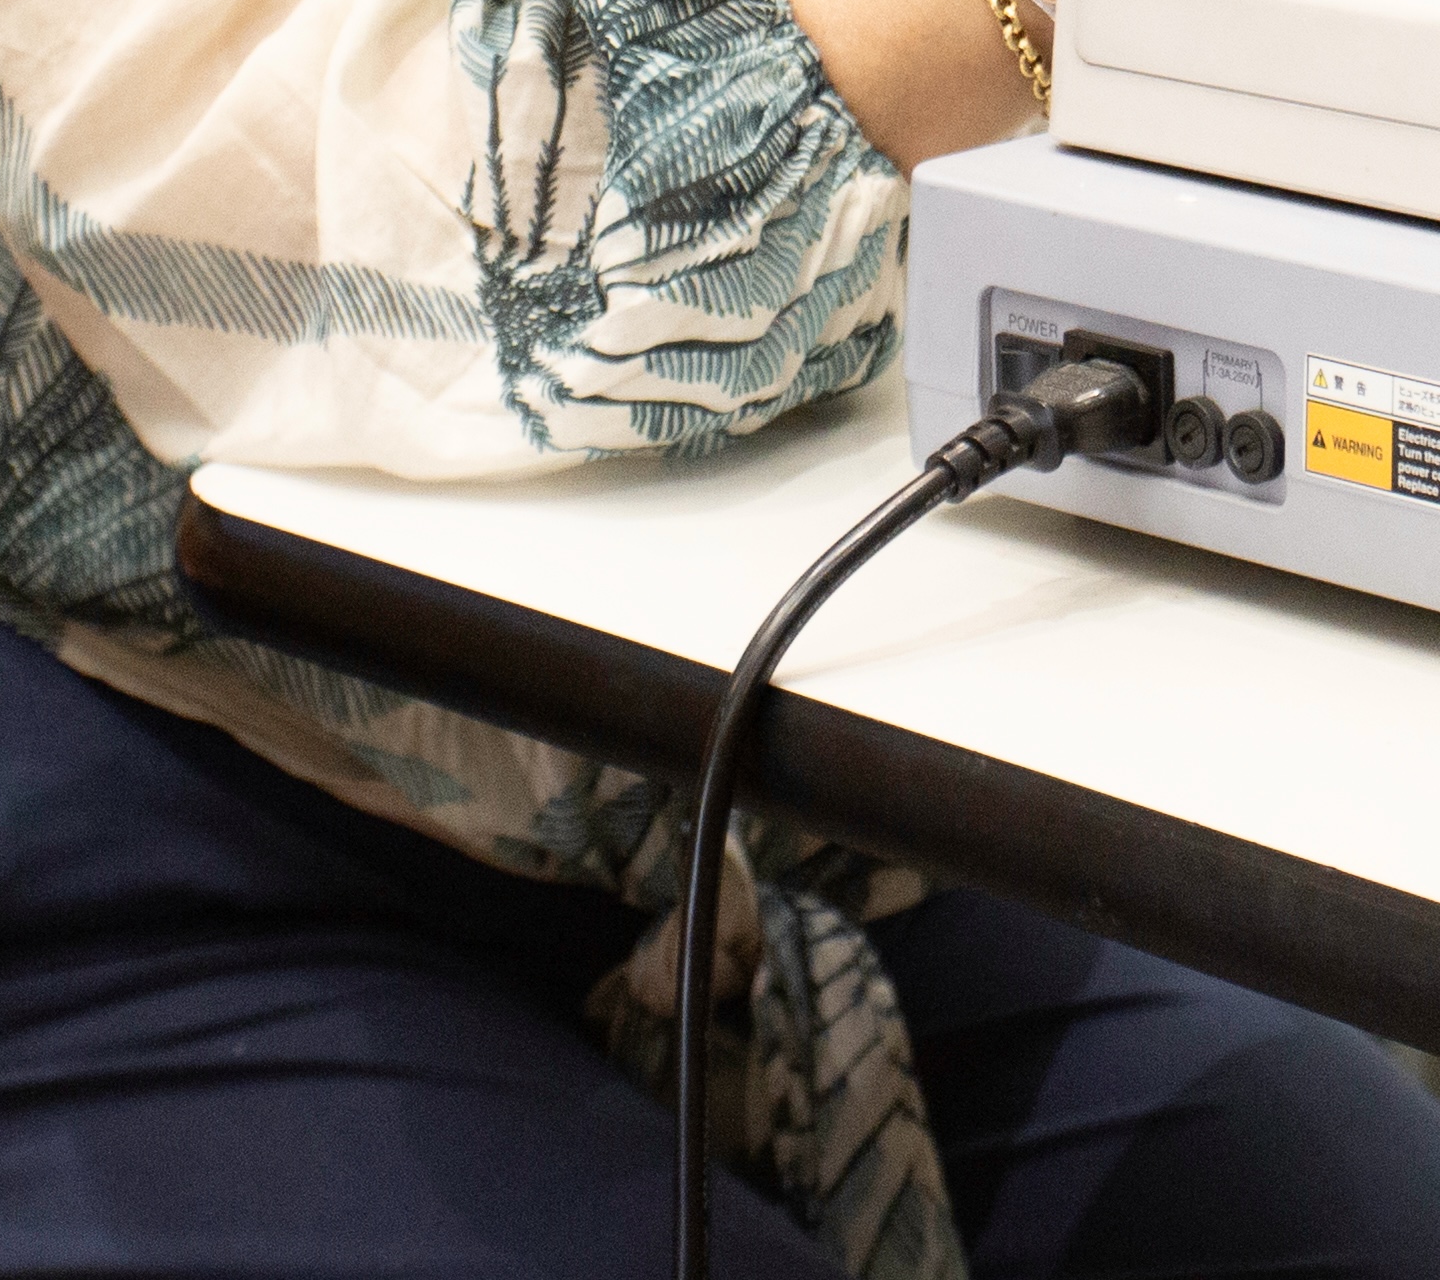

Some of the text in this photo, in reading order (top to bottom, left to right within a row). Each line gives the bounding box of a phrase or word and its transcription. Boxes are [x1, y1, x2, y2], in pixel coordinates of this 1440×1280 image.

[1008, 313, 1059, 340] POWER
[1210, 351, 1256, 372] PRIMARY
[1333, 436, 1383, 460] WARNING
[1398, 445, 1421, 460] Turn
[1424, 451, 1440, 465] the
[1397, 462, 1429, 480] power
[1397, 476, 1438, 498] Replace
